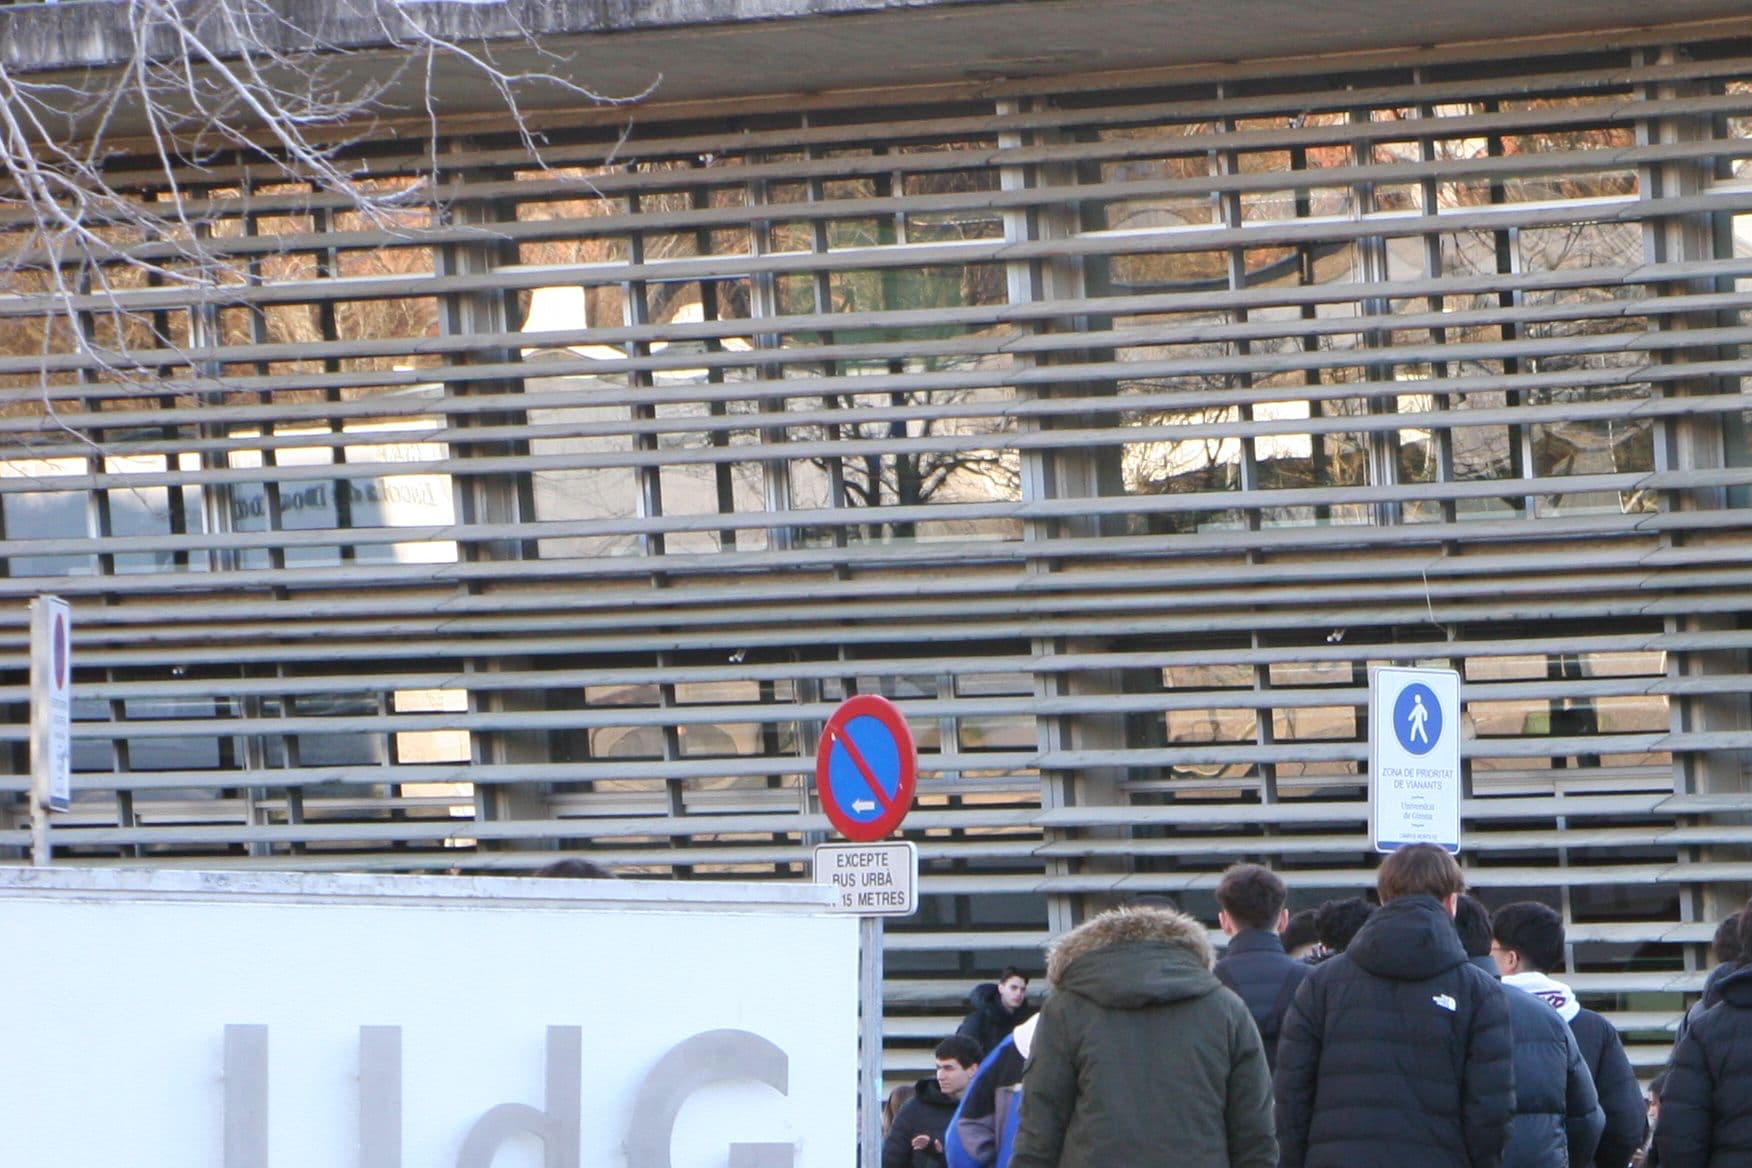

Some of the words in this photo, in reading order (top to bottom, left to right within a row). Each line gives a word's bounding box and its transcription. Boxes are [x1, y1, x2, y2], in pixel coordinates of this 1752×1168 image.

[1382, 768, 1402, 777] ZONA
[1404, 768, 1415, 777] DE
[1416, 768, 1453, 779] PRIORITAT
[1394, 780, 1405, 789] DE
[1406, 780, 1442, 790] VIANANTS
[836, 853, 889, 868] EXCEPTE
[861, 868, 893, 887] URBÀ
[842, 893, 853, 907] 15
[858, 891, 905, 906] METRES
